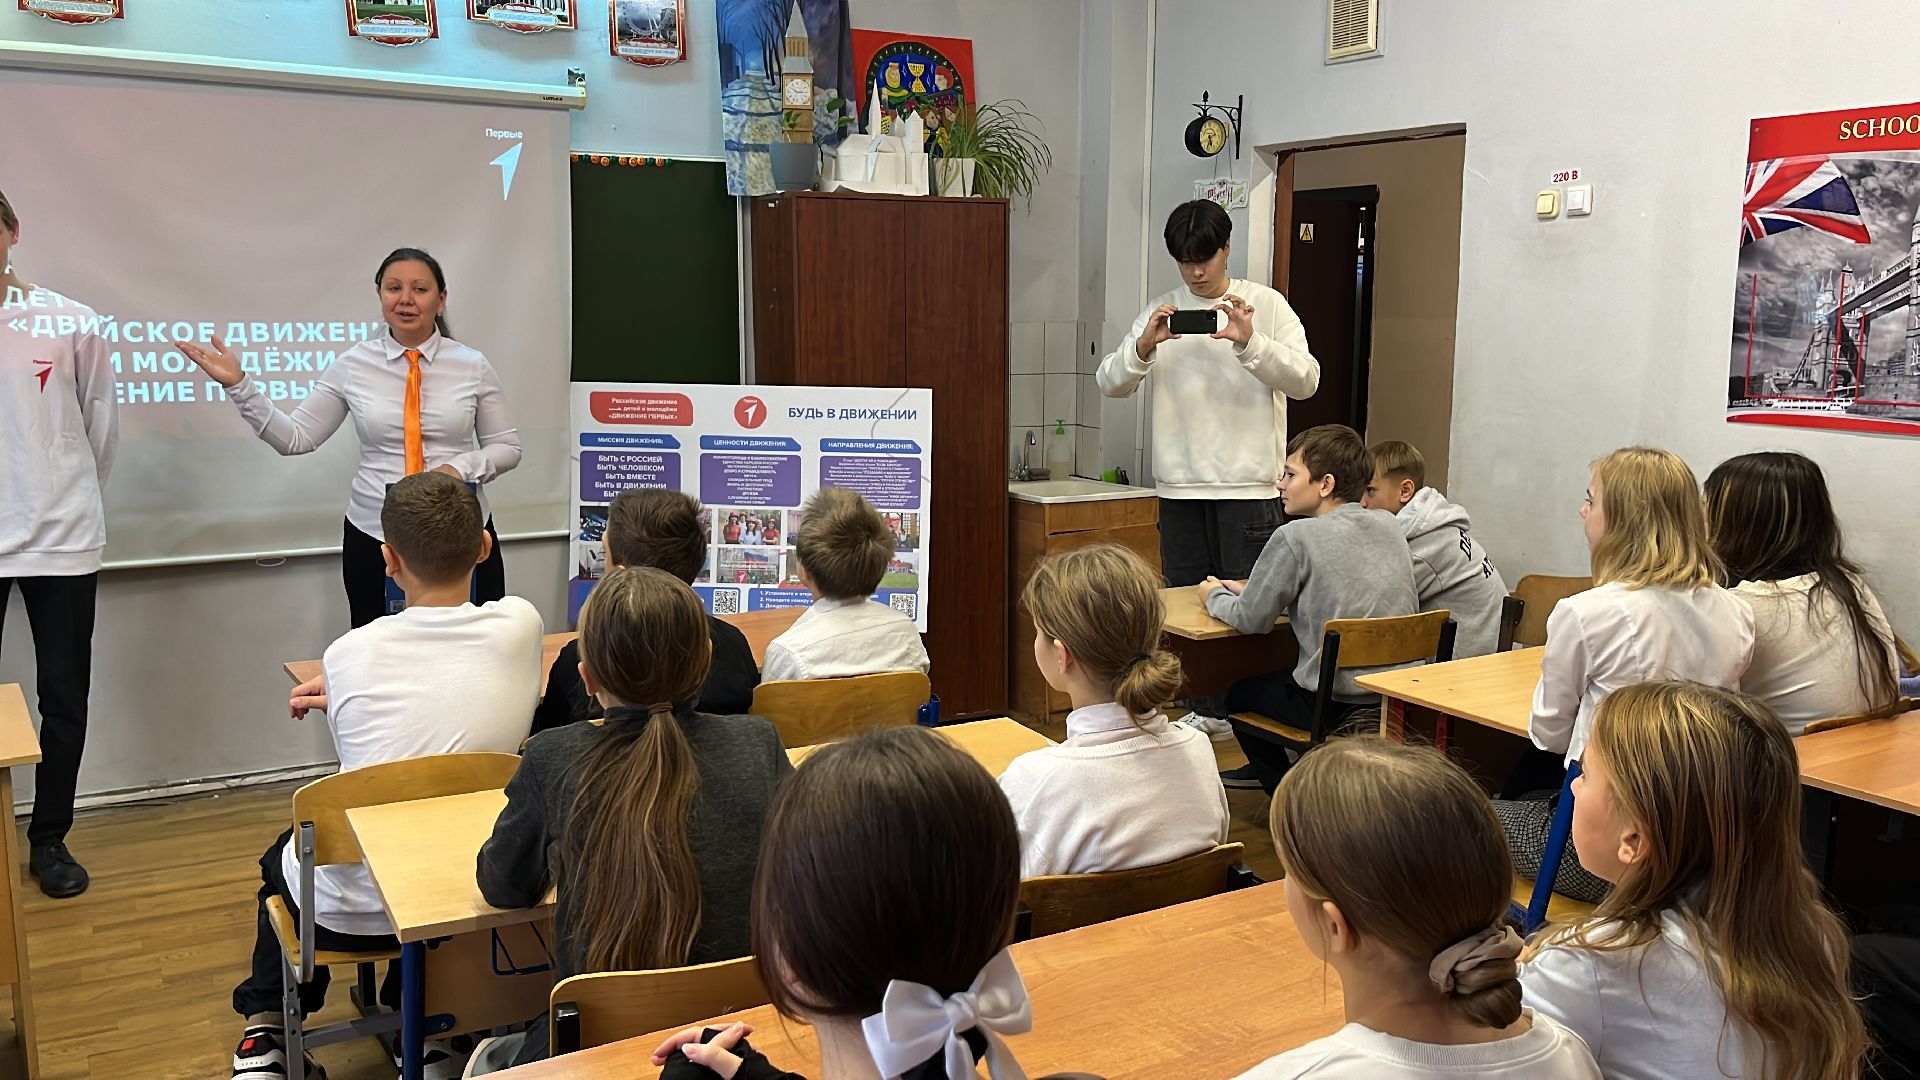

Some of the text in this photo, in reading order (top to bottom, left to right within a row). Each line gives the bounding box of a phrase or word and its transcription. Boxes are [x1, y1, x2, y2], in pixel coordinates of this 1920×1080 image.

[1839, 114, 1920, 140] SCHOO
[485, 128, 523, 140] Первые
[1553, 170, 1578, 183] 220 В
[224, 321, 380, 347] ДВИЖЕН
[788, 407, 917, 420] БУДЬ В ДВИЖЕНИИ
[620, 455, 626, 463] С
[626, 455, 663, 463] РОССИЕЙ
[596, 463, 665, 472] БЫТЬ ЧЕЛОВЕКОМ
[626, 473, 657, 481] ВМЕСТЕ
[594, 481, 615, 489] БЫТЬ
[622, 482, 667, 490] ДВИЖЕНИИ
[603, 490, 621, 498] БЫТ
